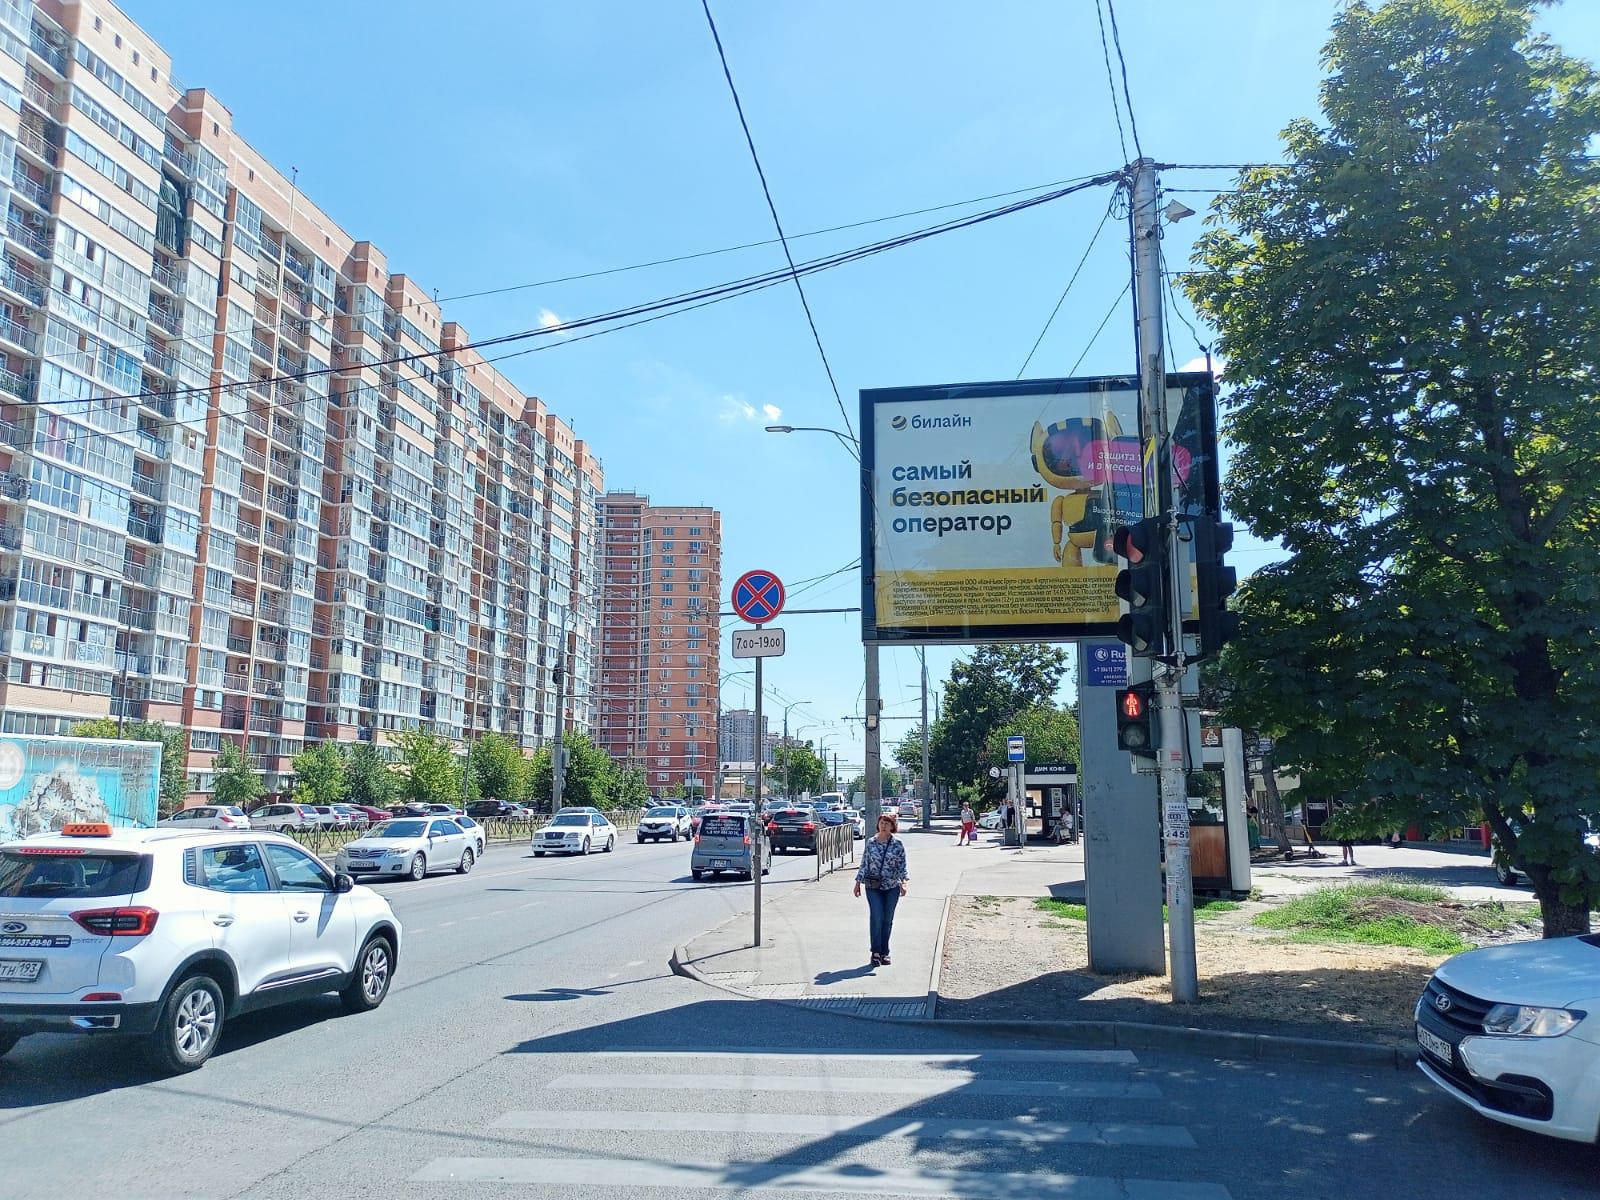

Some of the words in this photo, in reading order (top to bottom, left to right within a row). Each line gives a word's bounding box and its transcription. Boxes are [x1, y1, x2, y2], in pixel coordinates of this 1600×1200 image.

[911, 414, 972, 430] билайн
[891, 459, 973, 482] самый
[892, 483, 1044, 507] безопасный
[892, 514, 1013, 537] оператор
[736, 636, 781, 650] 7.00-19.00
